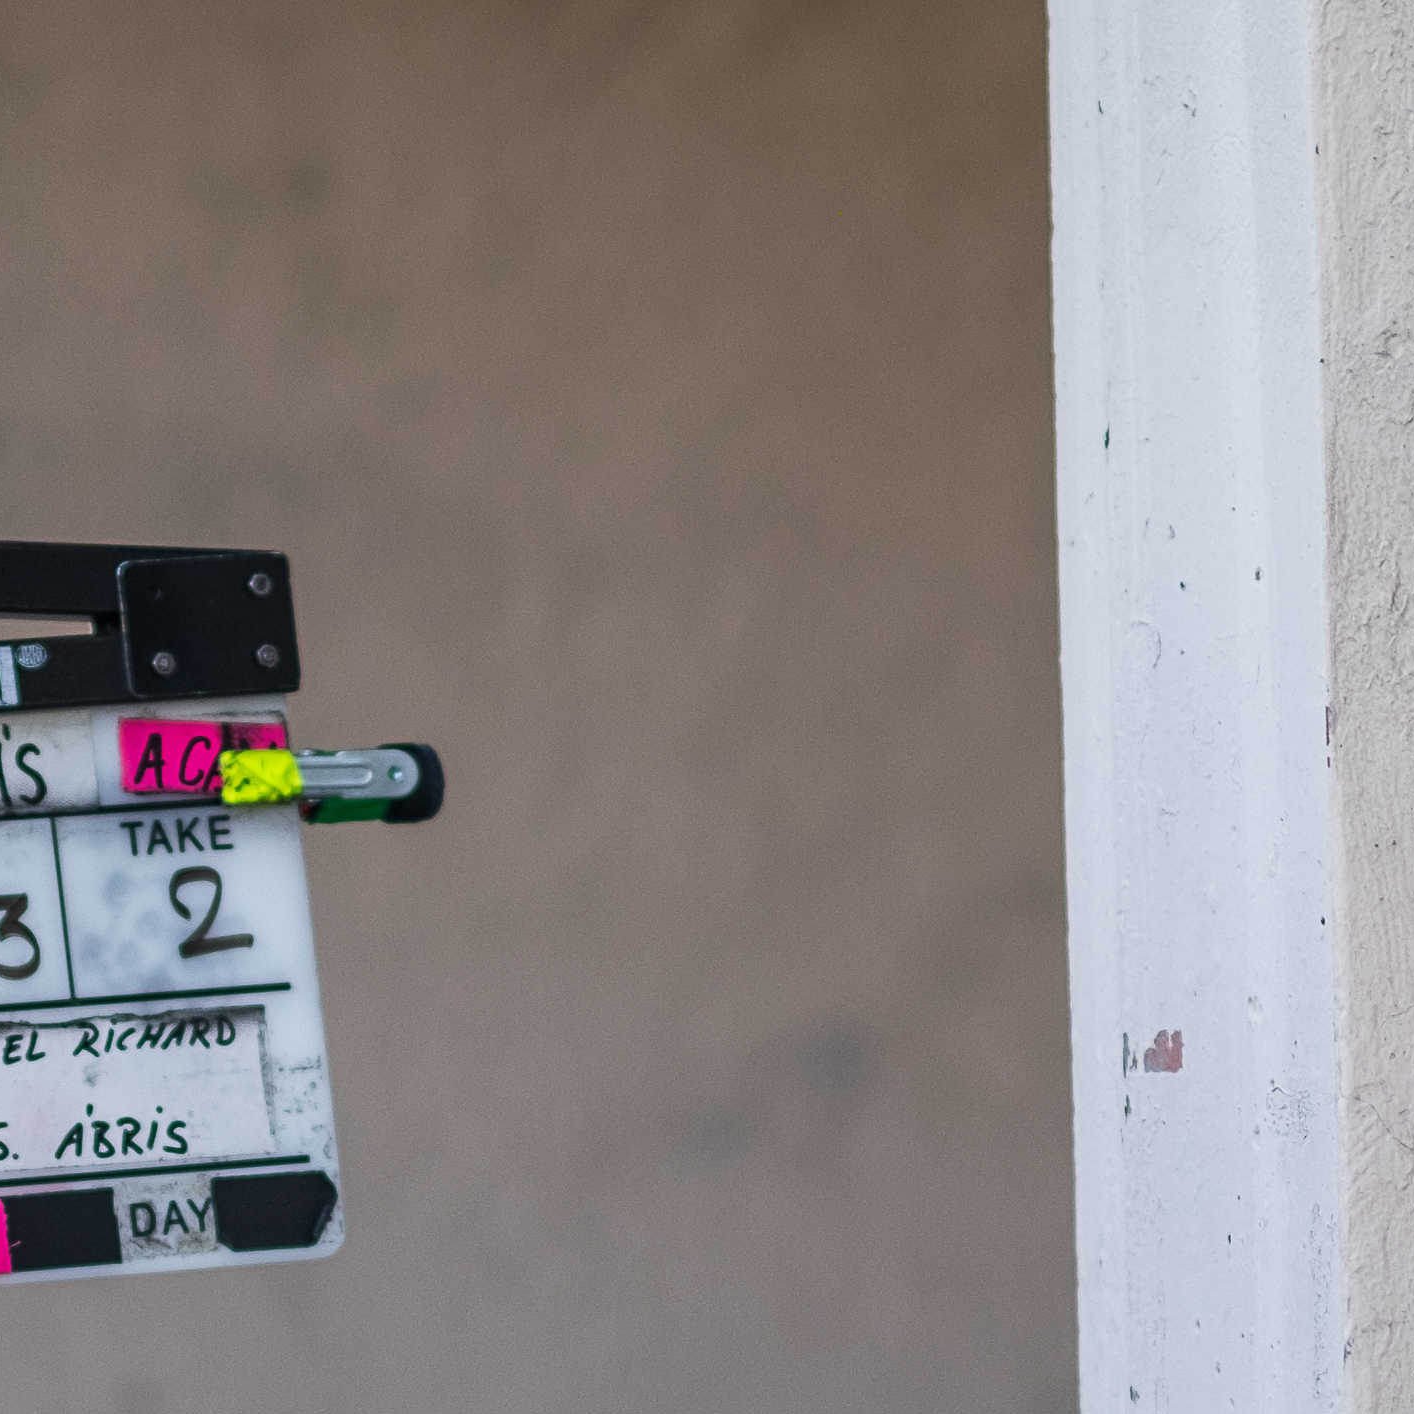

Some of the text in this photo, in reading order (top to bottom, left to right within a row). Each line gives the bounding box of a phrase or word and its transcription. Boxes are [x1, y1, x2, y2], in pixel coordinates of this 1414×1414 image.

[133, 732, 166, 789] A
[119, 814, 235, 857] TAKE
[168, 865, 255, 960] 2
[128, 1196, 213, 1238] DAY
